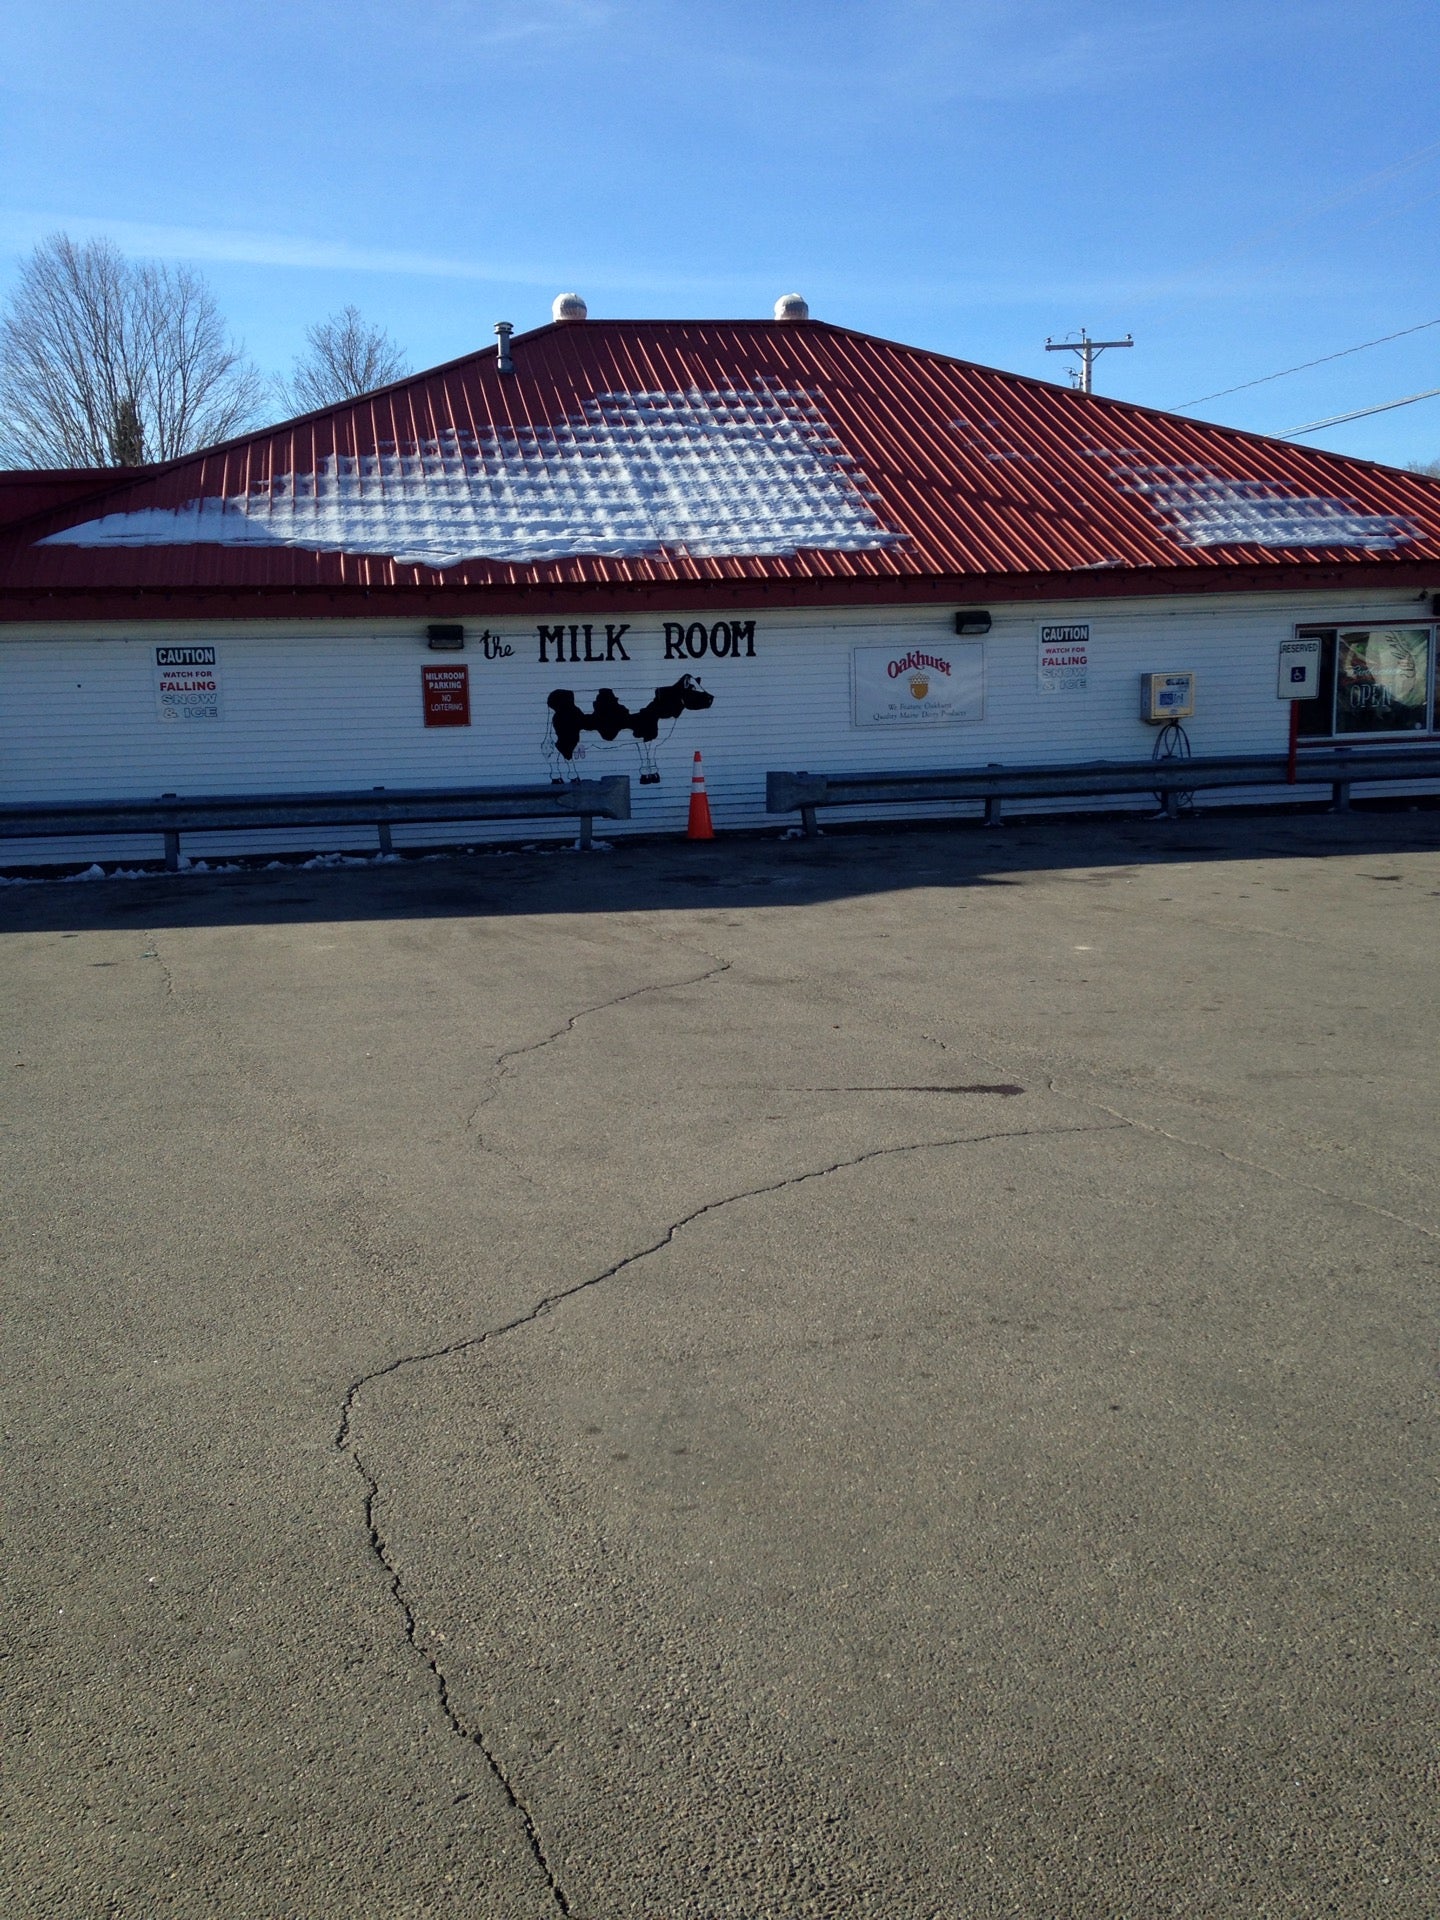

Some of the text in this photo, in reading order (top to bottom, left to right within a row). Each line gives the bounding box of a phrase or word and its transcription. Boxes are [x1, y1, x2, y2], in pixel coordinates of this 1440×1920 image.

[1043, 626, 1088, 641] CAUTION
[479, 620, 757, 662] the MILK ROOM
[1282, 643, 1318, 653] RESERVED
[157, 648, 214, 664] CAUTION
[1042, 656, 1088, 666] FALLING
[887, 650, 952, 679] Oakhurst
[425, 672, 465, 680] MILKROOM
[1042, 667, 1087, 679] SNOW
[160, 681, 216, 691] FALLING
[429, 681, 462, 689] PARKING
[161, 693, 217, 705] SNOW
[441, 694, 451, 702] NO
[1350, 683, 1392, 708] OPEN
[184, 706, 218, 718] ICE
